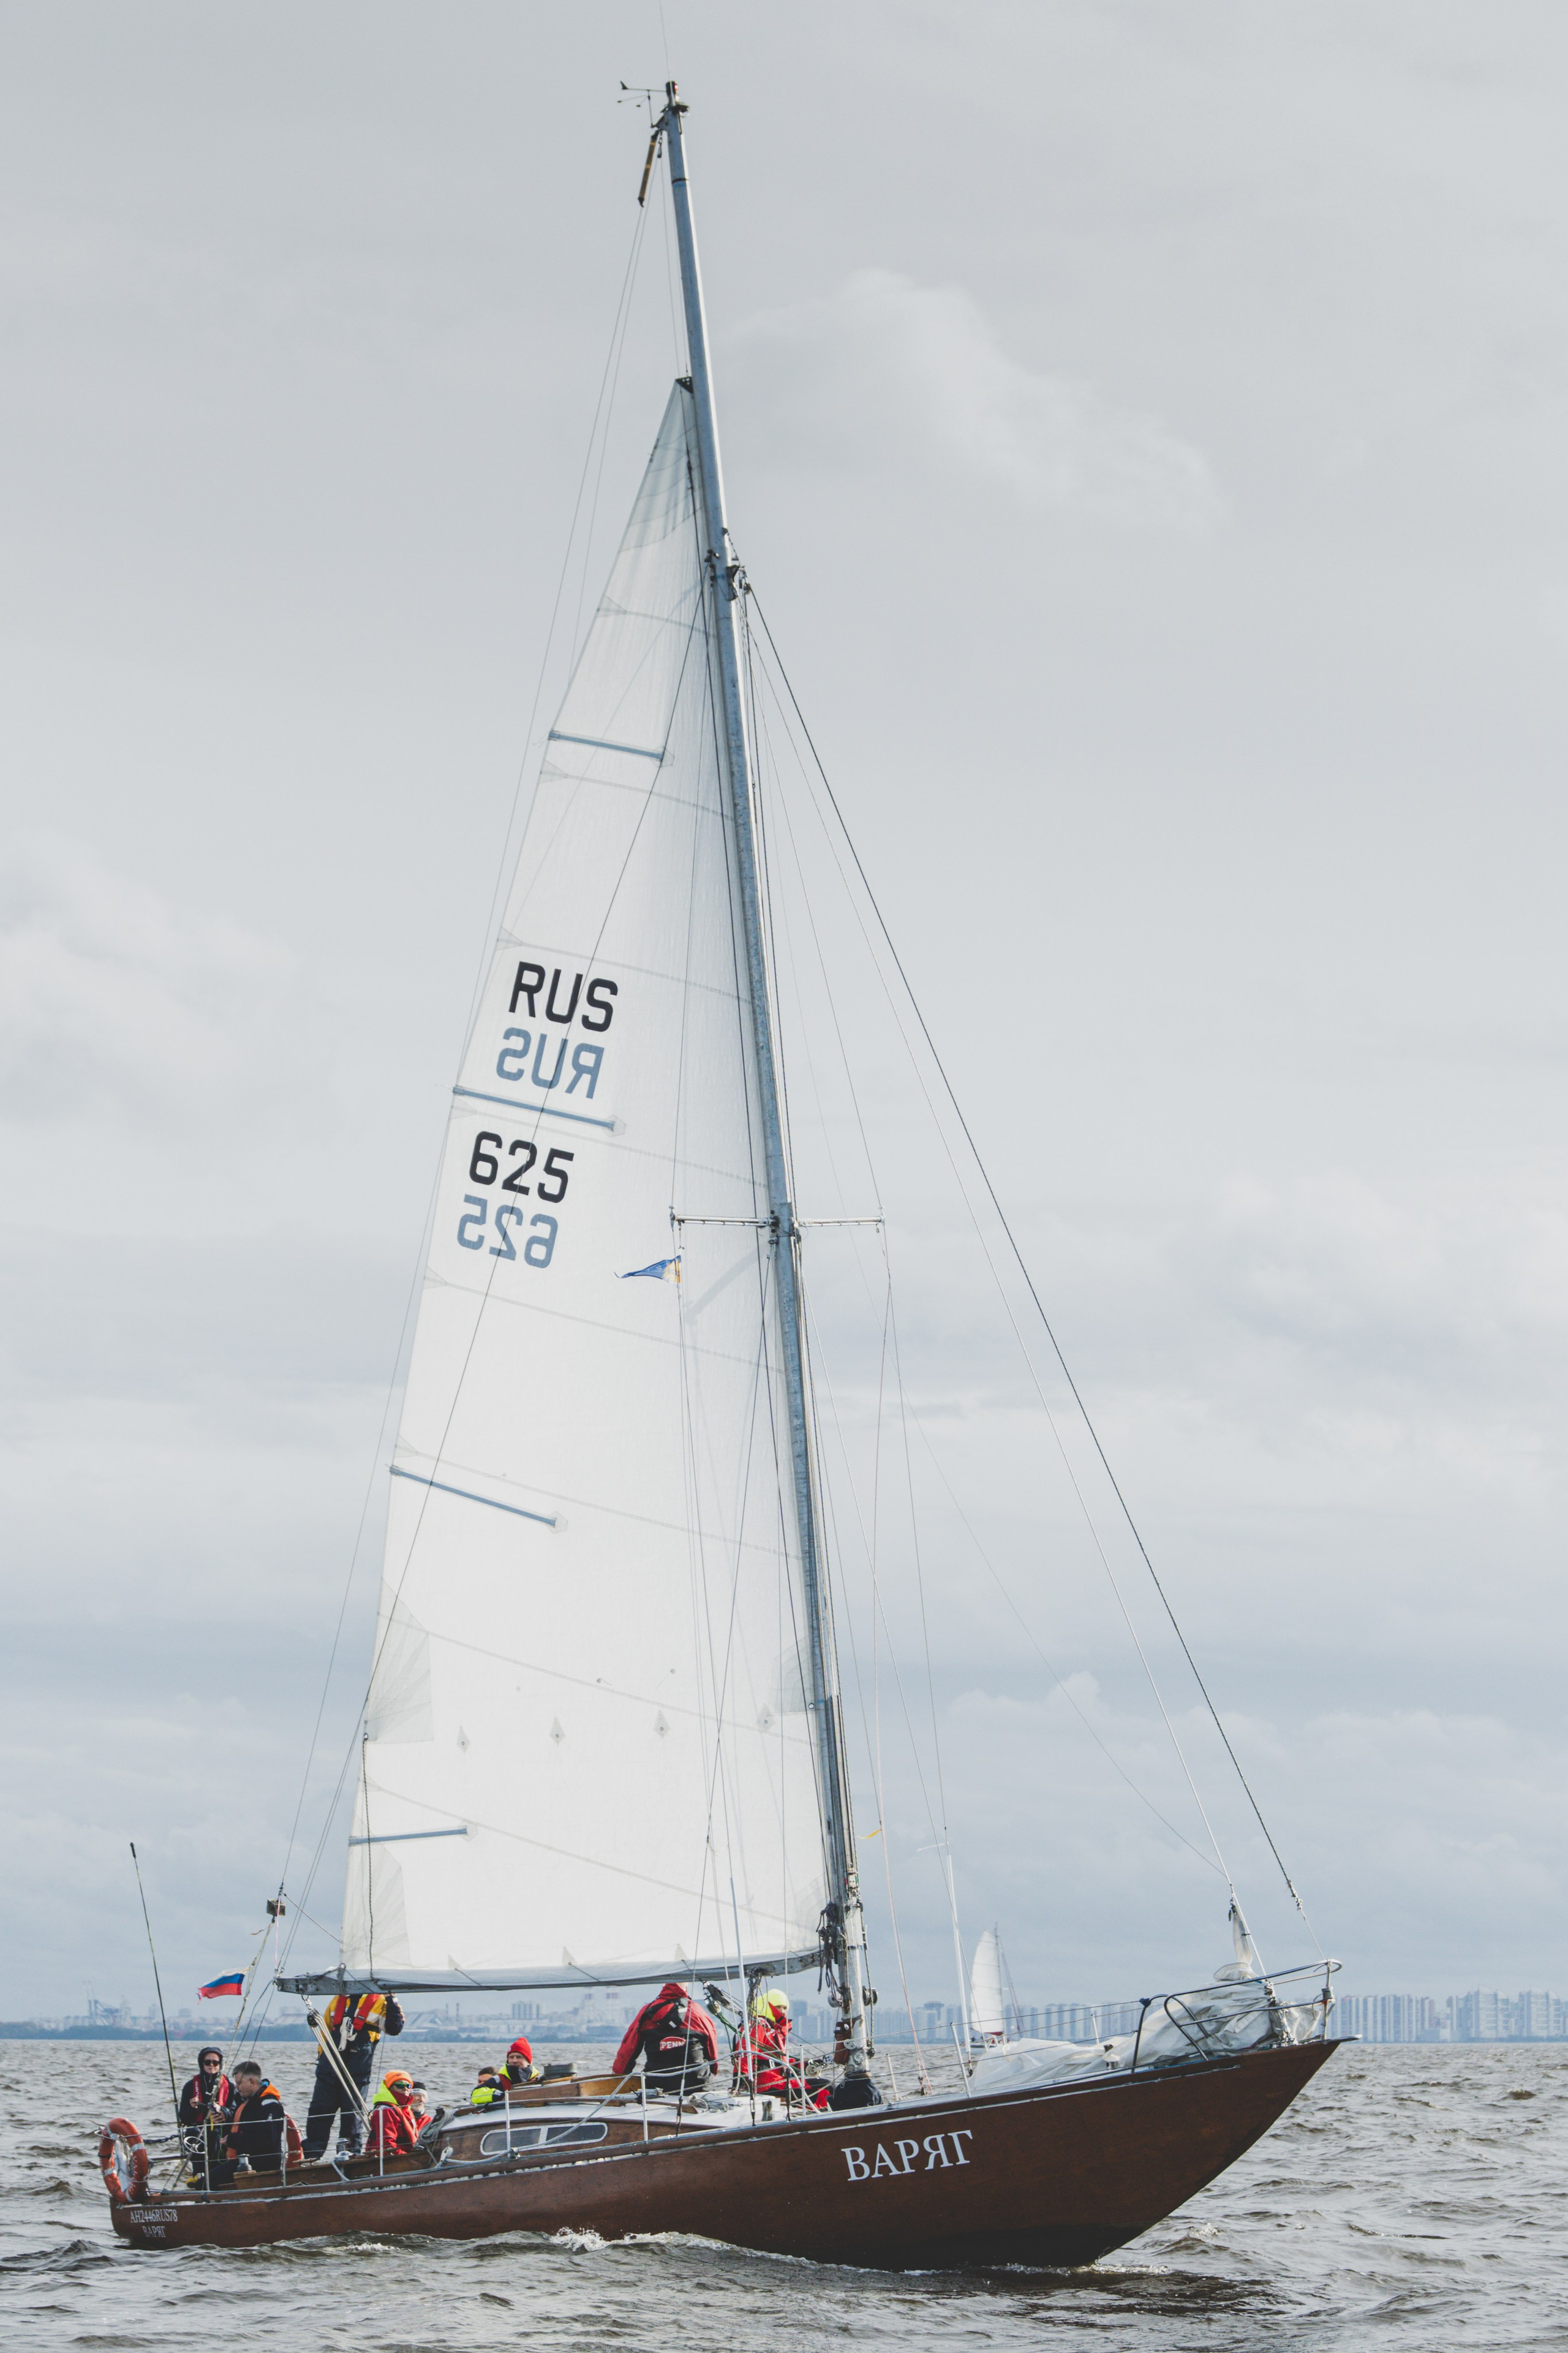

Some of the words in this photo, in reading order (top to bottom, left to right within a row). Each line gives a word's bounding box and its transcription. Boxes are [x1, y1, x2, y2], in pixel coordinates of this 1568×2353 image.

[508, 961, 618, 1032] RUS
[469, 1131, 575, 1203] 625
[841, 2129, 973, 2181] ВАРЯГ
[141, 2226, 166, 2238] ВАРЯГ
